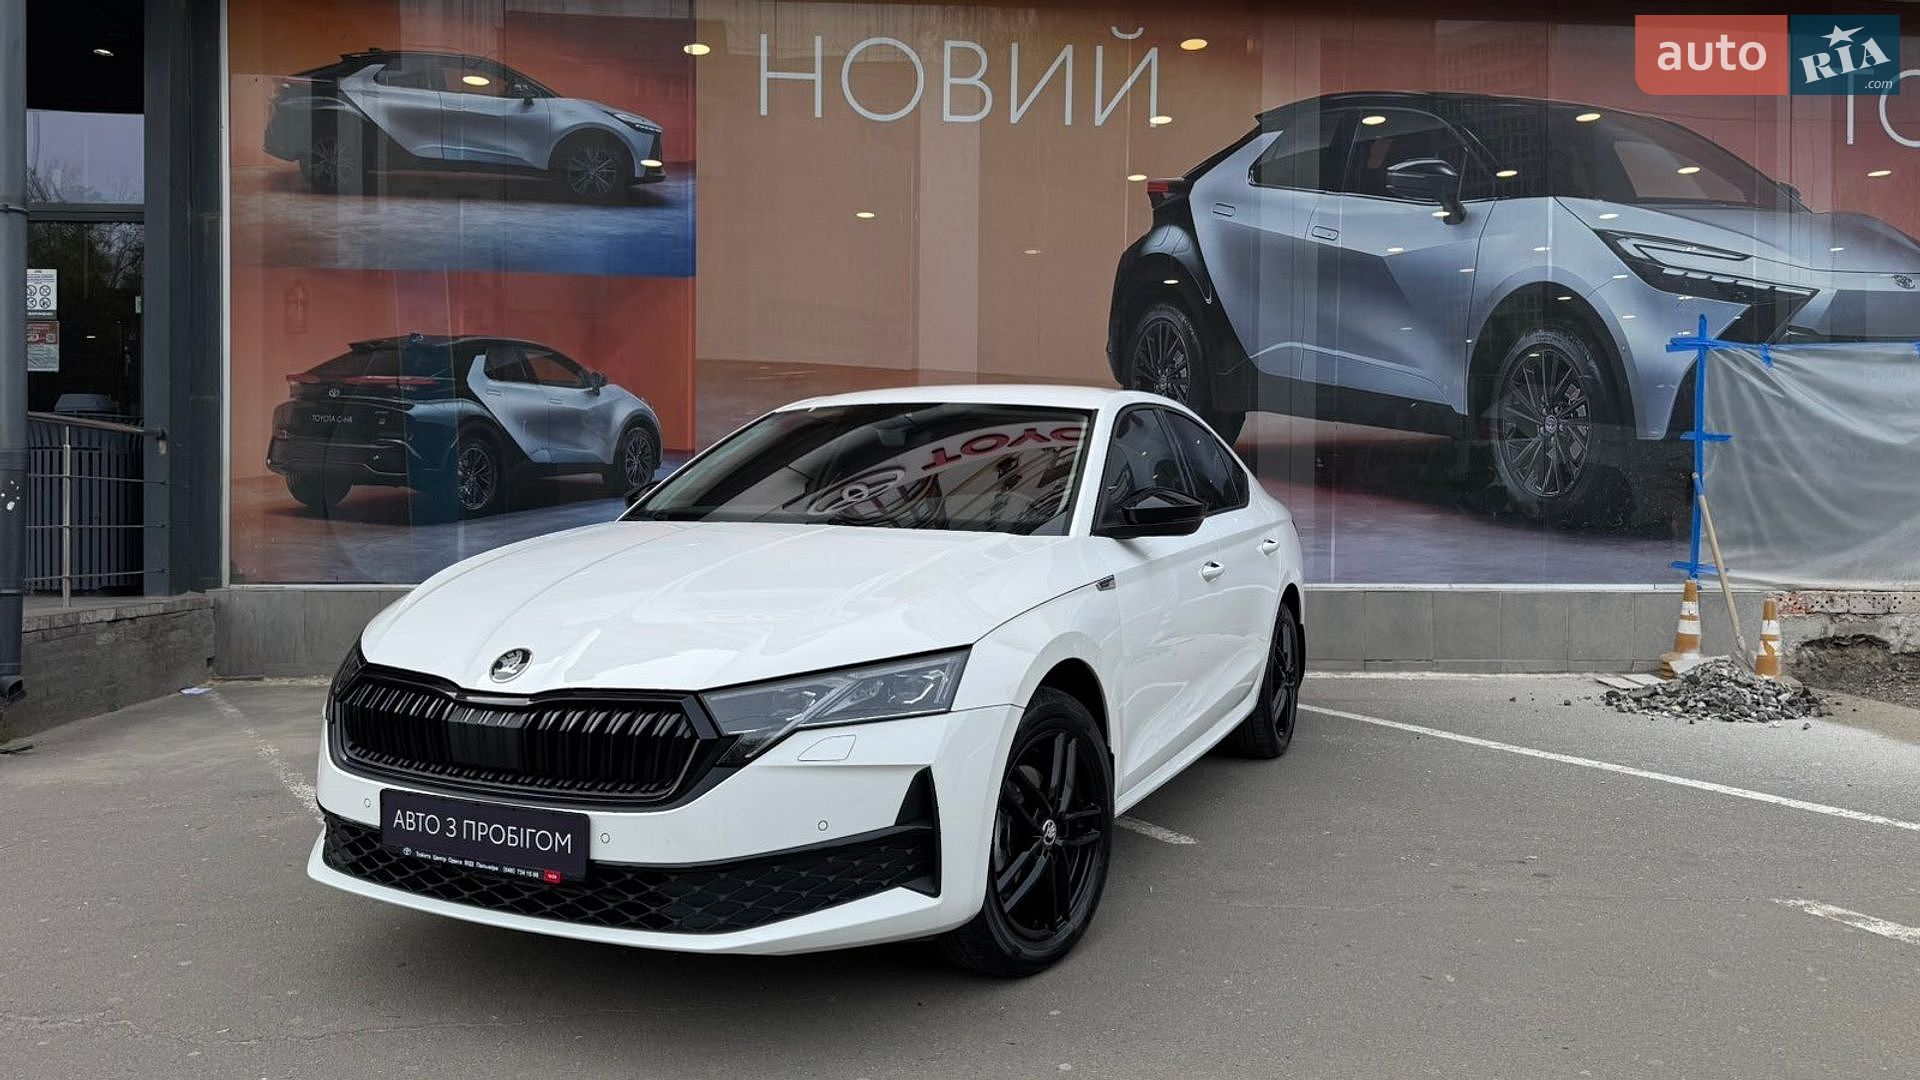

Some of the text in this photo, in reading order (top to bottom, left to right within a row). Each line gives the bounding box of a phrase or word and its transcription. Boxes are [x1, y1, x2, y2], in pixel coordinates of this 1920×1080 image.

[760, 26, 1158, 128] НОВИЙ
[393, 809, 440, 835] АВТО
[463, 820, 572, 855] ПРОБІГОМ
